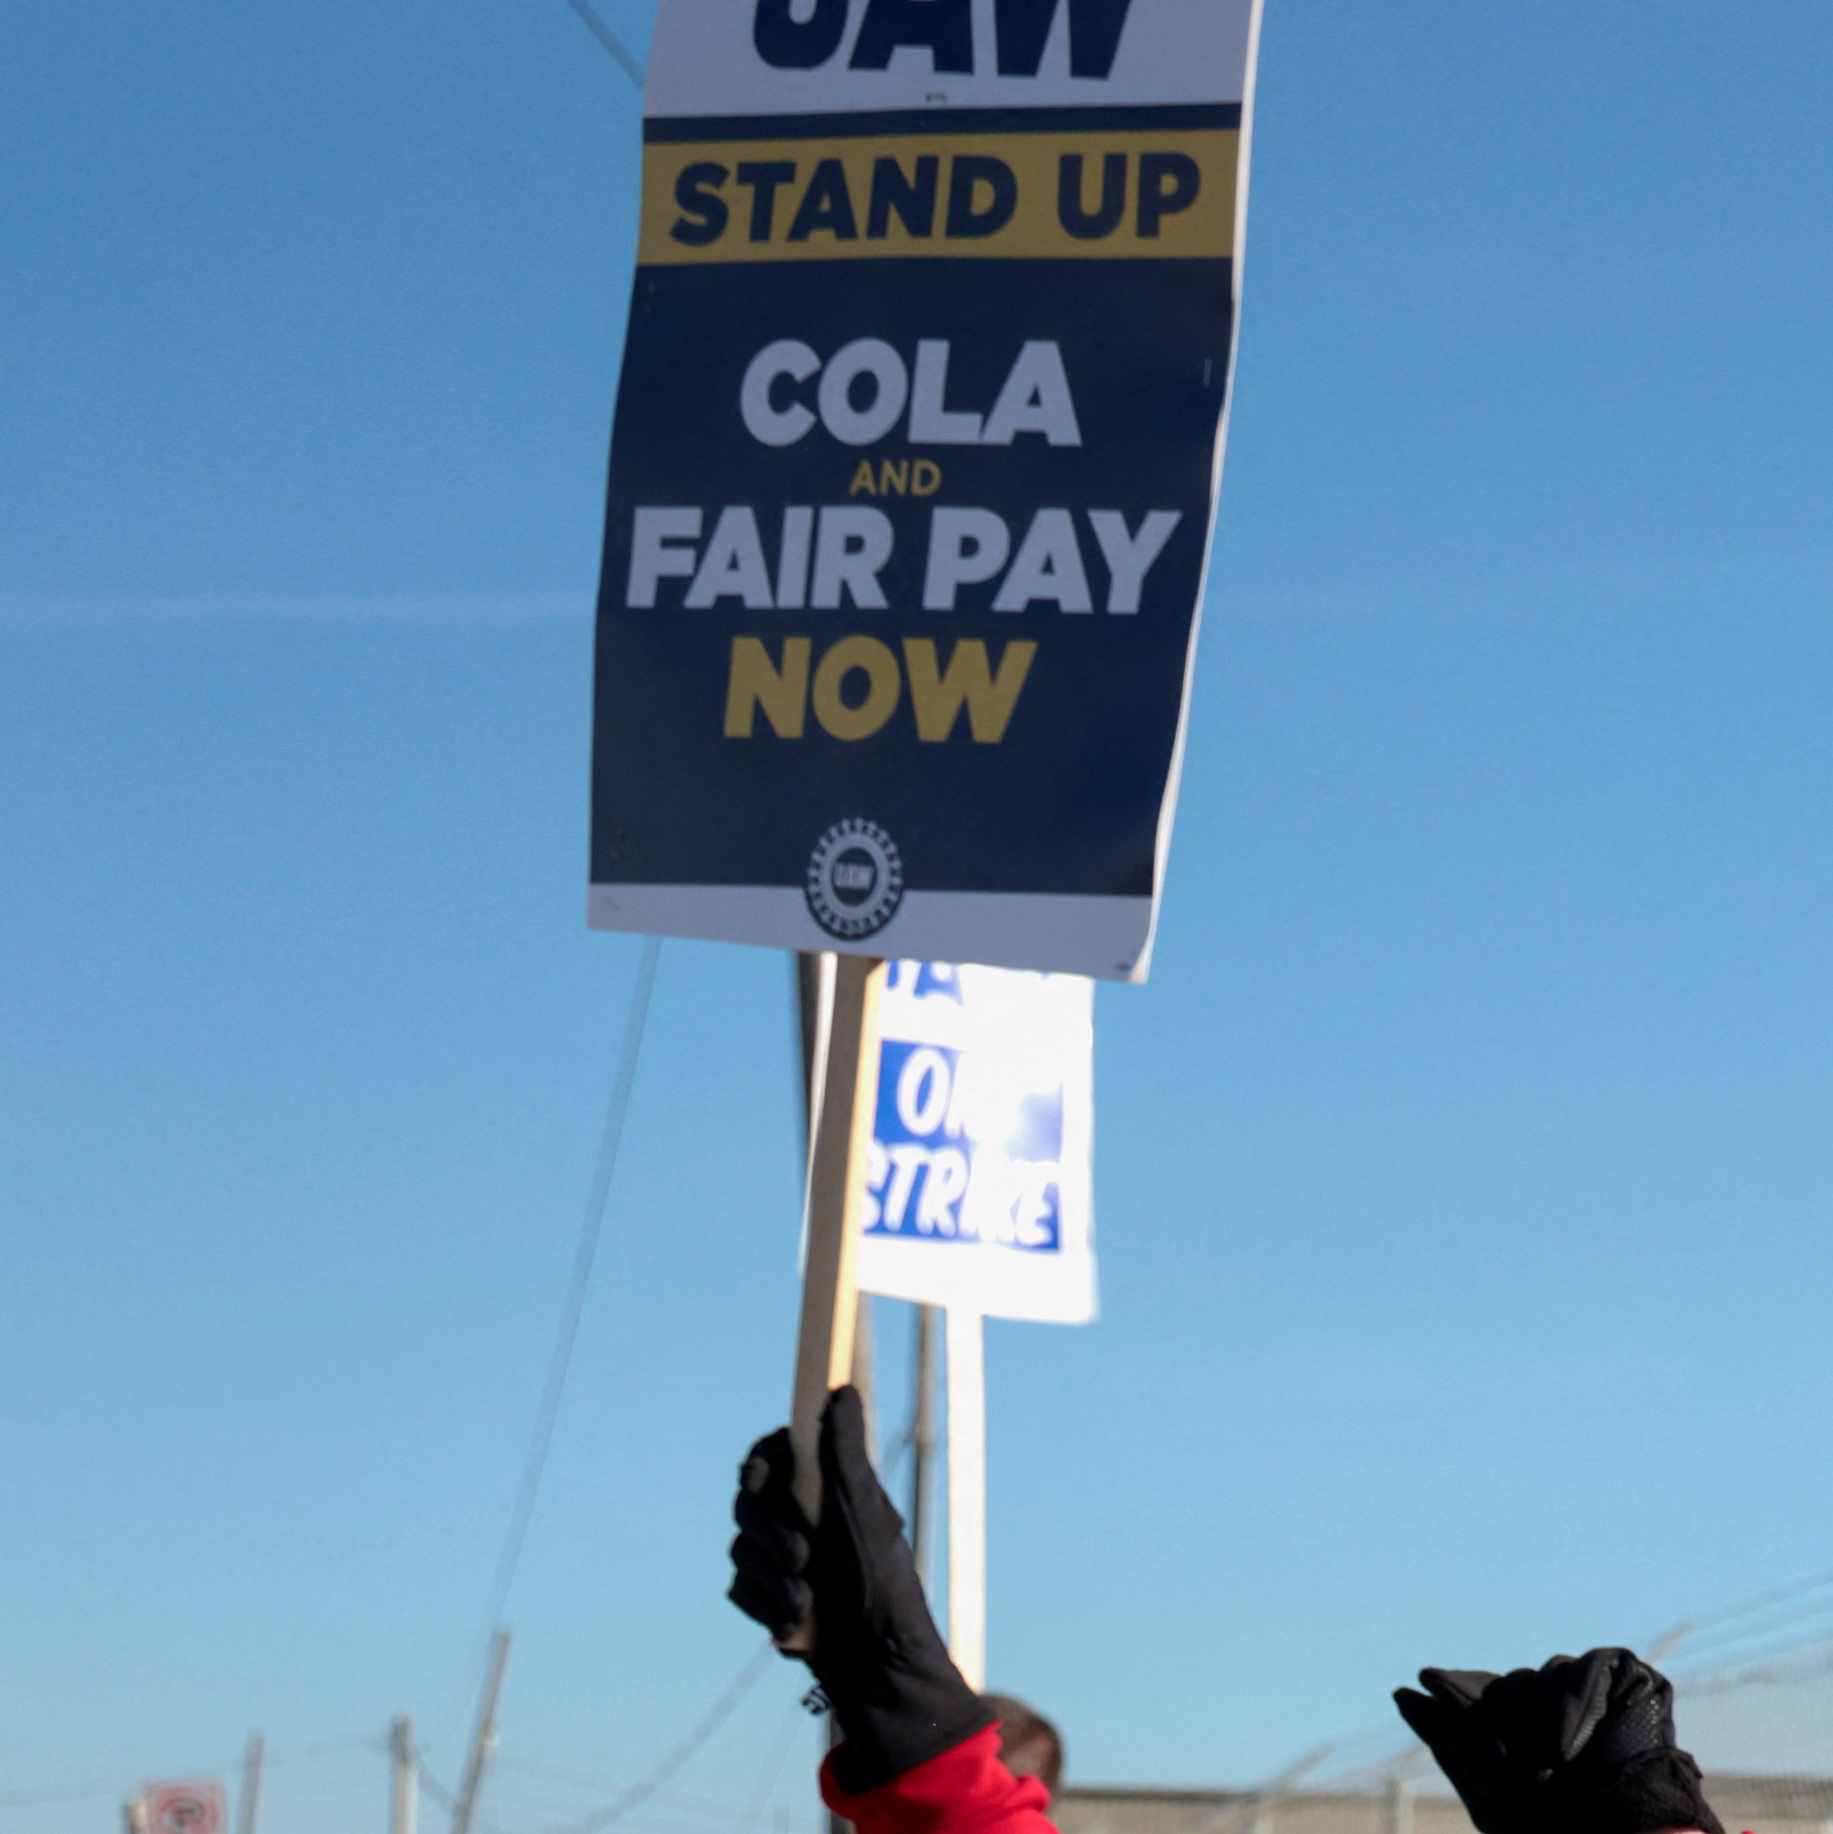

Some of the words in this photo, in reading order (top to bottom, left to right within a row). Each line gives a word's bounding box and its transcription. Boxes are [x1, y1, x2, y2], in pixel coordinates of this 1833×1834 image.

[669, 155, 1019, 246] STAND
[1056, 152, 1202, 242] UP
[739, 337, 1083, 449] COLA
[849, 459, 942, 498] AND
[626, 505, 895, 611] FAIR
[922, 506, 1183, 615] PAY
[723, 634, 1039, 743] NOW
